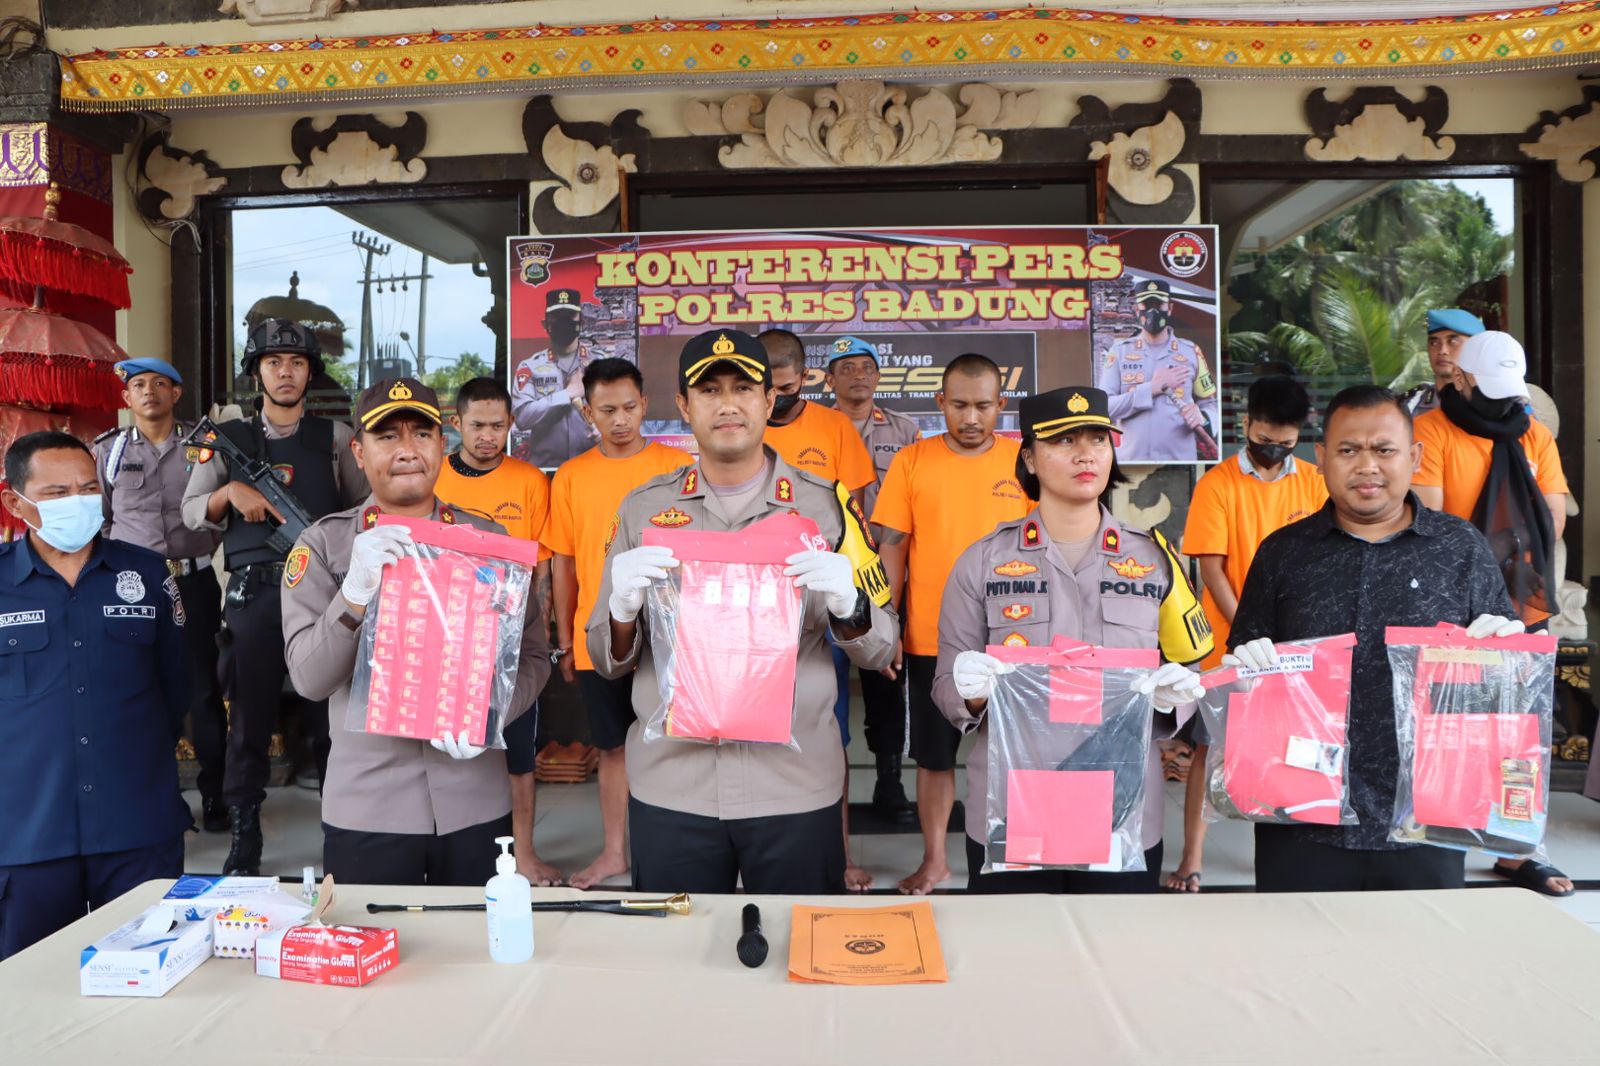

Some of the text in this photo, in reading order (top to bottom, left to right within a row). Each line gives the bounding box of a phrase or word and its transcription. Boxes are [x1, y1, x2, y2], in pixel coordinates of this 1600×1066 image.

[596, 244, 1124, 287] KONFERENSI PERS
[638, 288, 1090, 325] POLRES BADUNG
[893, 355, 933, 367] YANG
[986, 581, 1011, 597] PUTU
[1100, 581, 1164, 600] POLRI
[0, 612, 42, 625] SUKARMA
[106, 607, 154, 617] POLRI
[1279, 655, 1305, 664] BUKTI
[282, 952, 330, 966] Examination
[330, 953, 356, 968] Gloves
